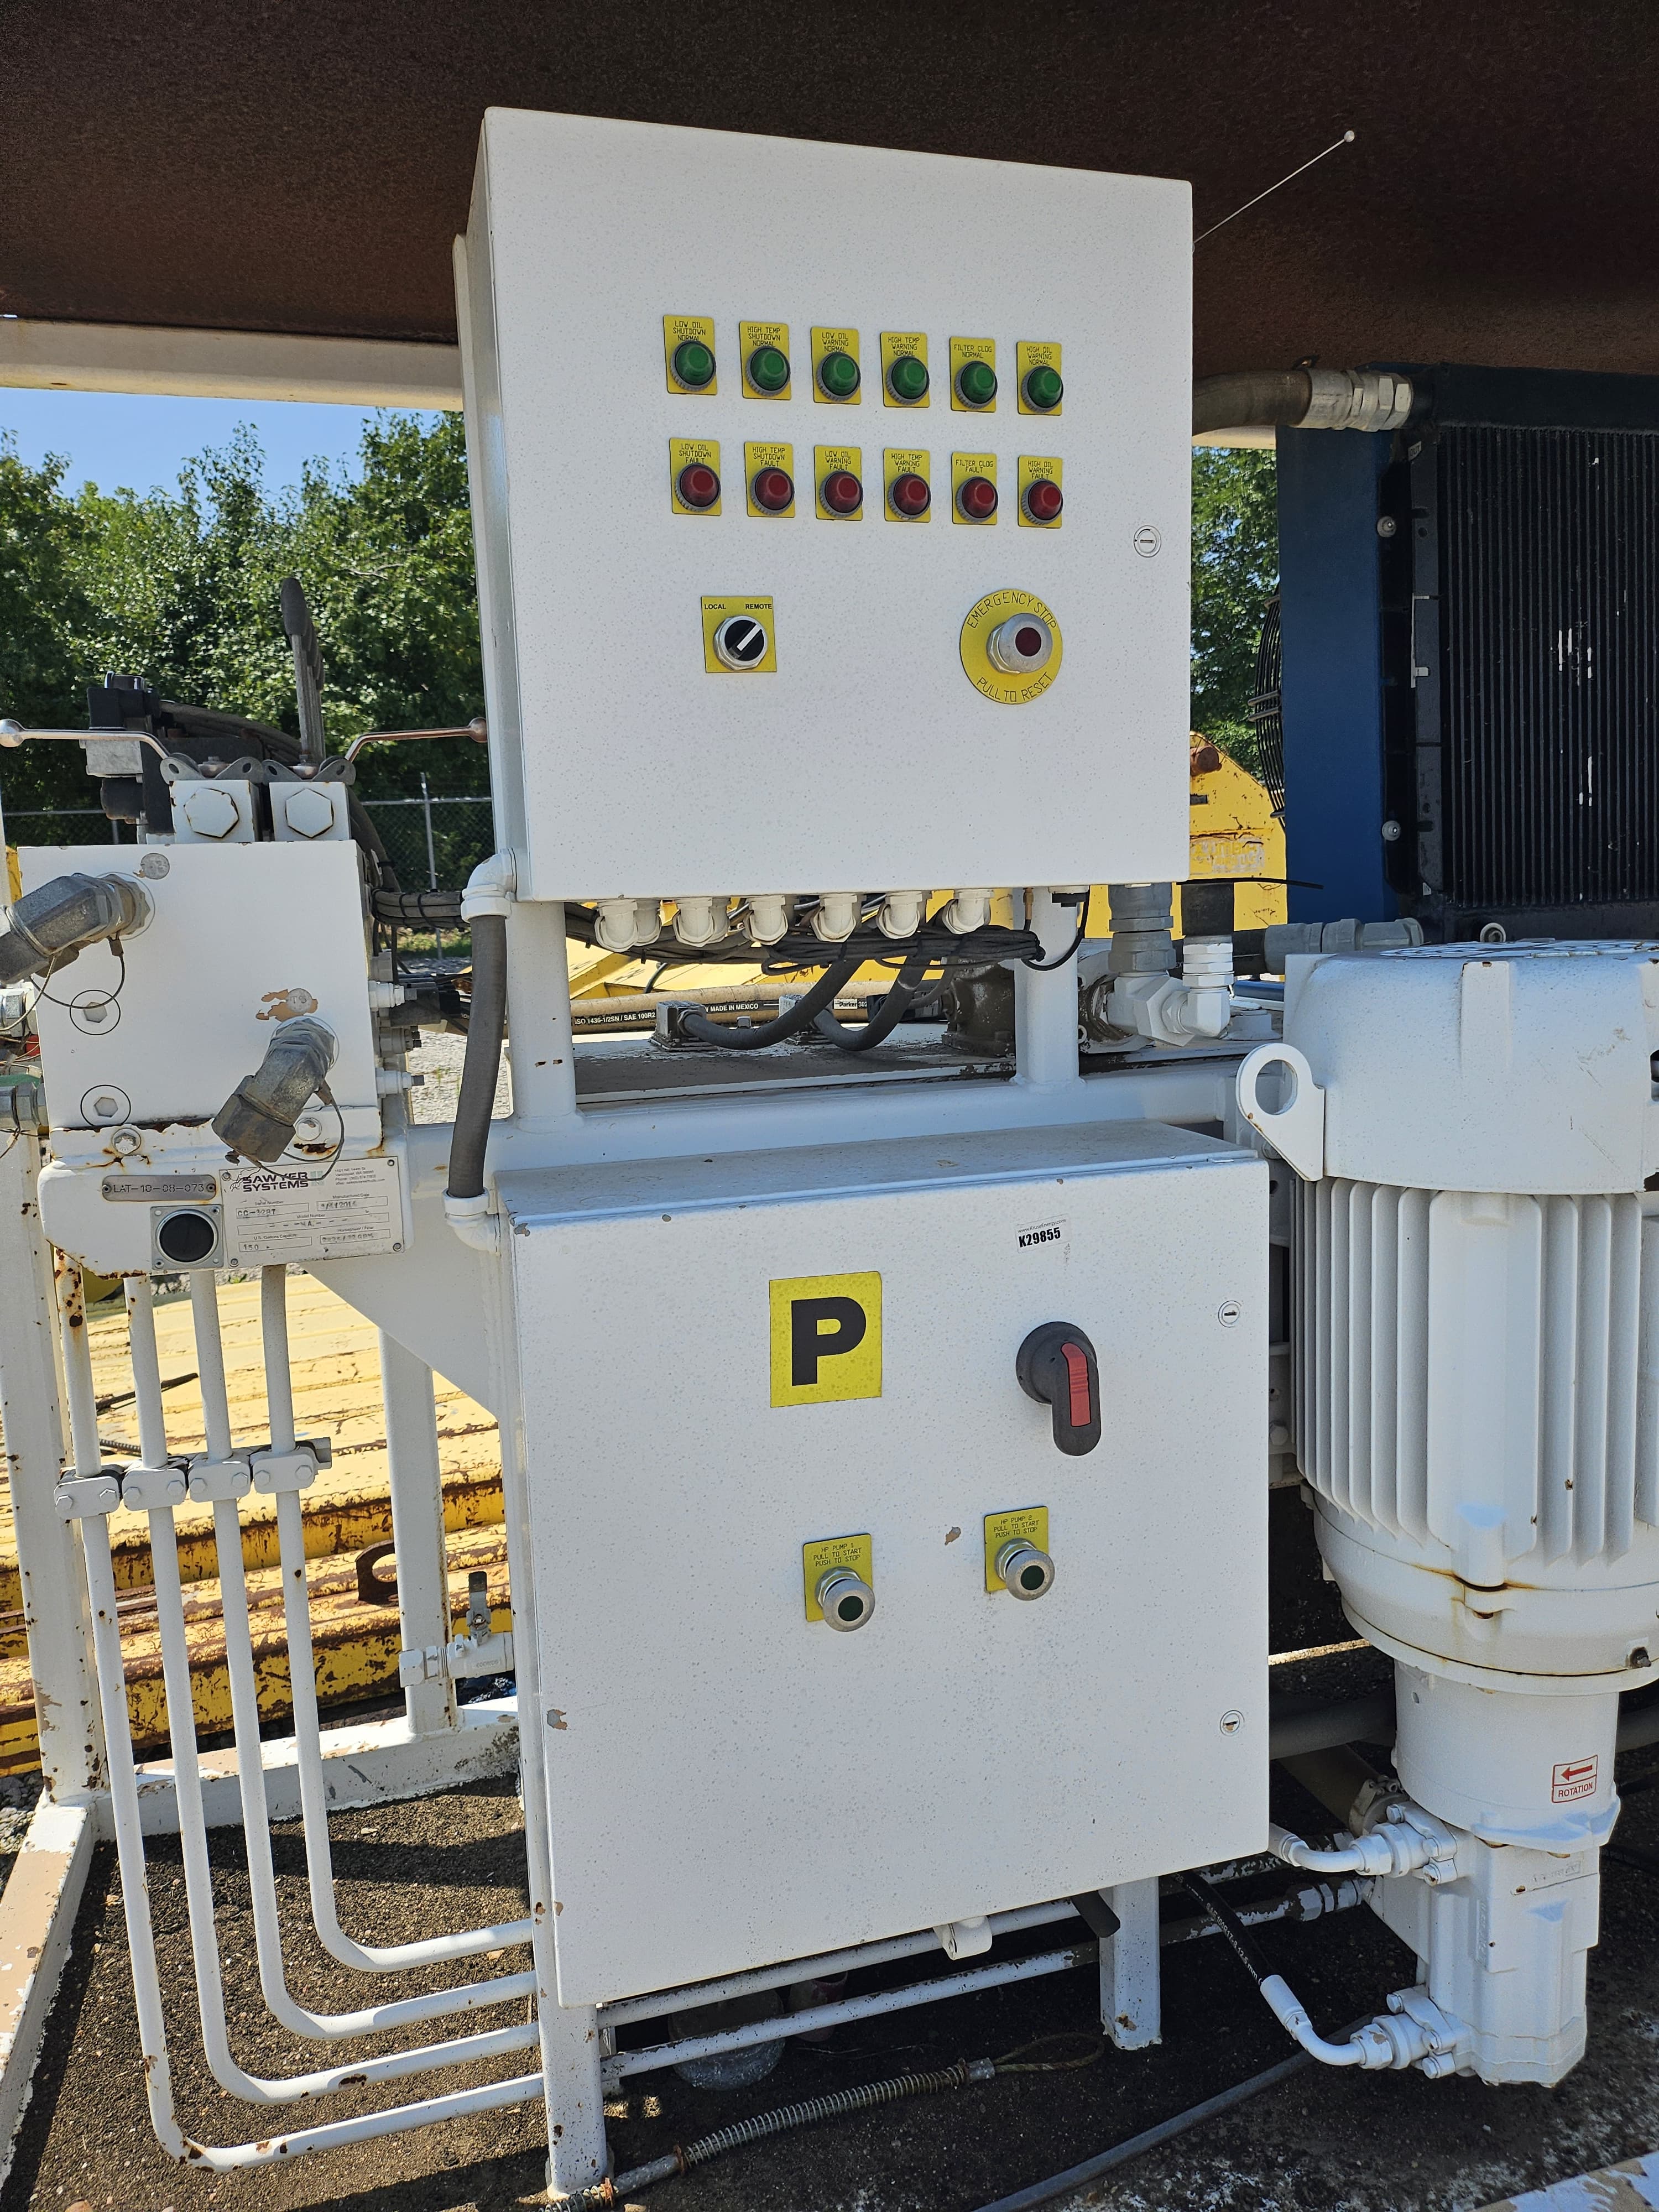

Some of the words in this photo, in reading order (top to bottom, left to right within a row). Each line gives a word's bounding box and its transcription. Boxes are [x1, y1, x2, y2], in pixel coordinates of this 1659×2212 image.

[673, 327, 706, 336] SHUTDOWN
[679, 450, 712, 458] SHUTDOWN
[967, 592, 1034, 629] EMERGENCY
[1034, 602, 1056, 629] STOP
[977, 677, 1000, 700] PULL
[1004, 690, 1017, 702] TO
[1021, 671, 1052, 701] RESET
[243, 1172, 308, 1183] SAWYER
[243, 1181, 309, 1192] SYSTEMS
[1018, 1219, 1066, 1233] www.KruseEnergy.com
[1019, 1227, 1061, 1248] K29855
[791, 1296, 867, 1386] P
[843, 1547, 862, 1556] START
[1558, 1782, 1593, 1797] ROTATION
